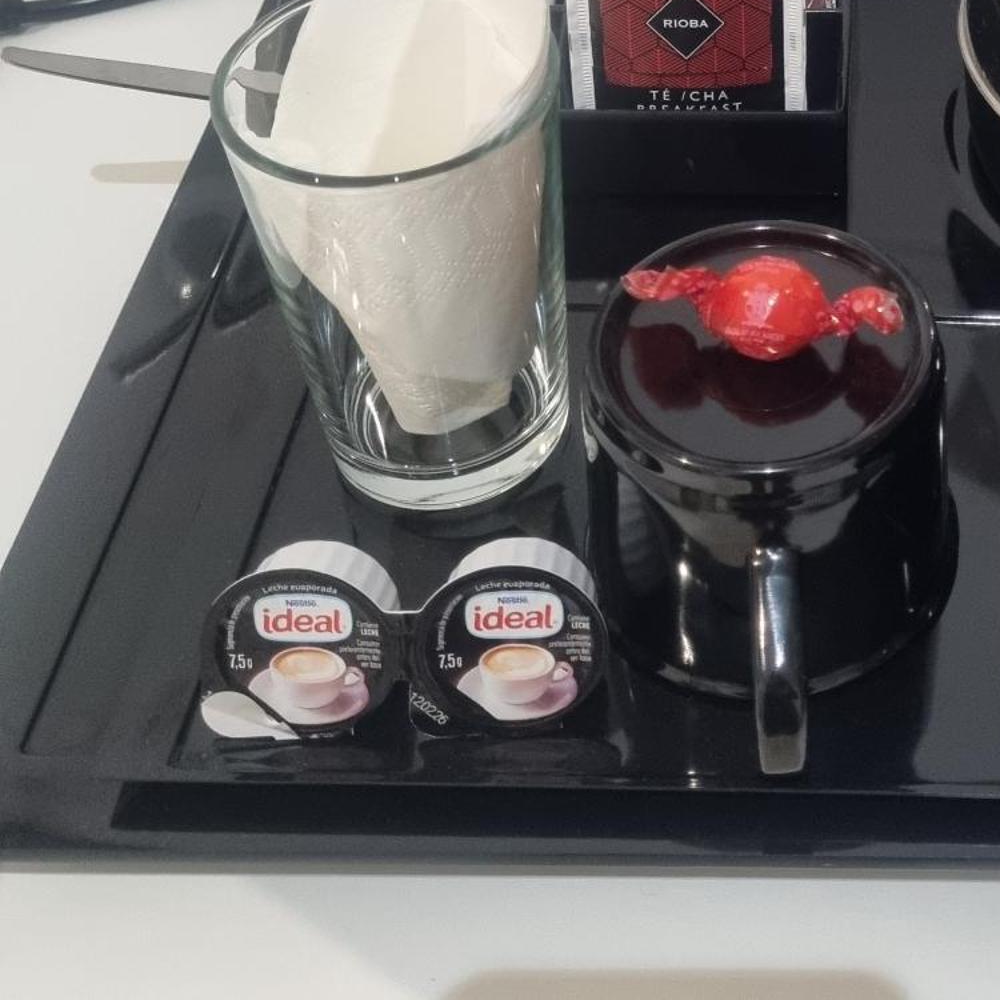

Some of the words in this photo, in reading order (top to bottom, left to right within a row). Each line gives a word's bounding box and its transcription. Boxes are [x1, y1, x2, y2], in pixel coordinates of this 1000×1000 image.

[662, 18, 709, 29] RIOBA
[649, 88, 671, 101] TÉ
[263, 608, 343, 634] ideal
[474, 604, 553, 632] ideal
[410, 692, 449, 726] 120226
